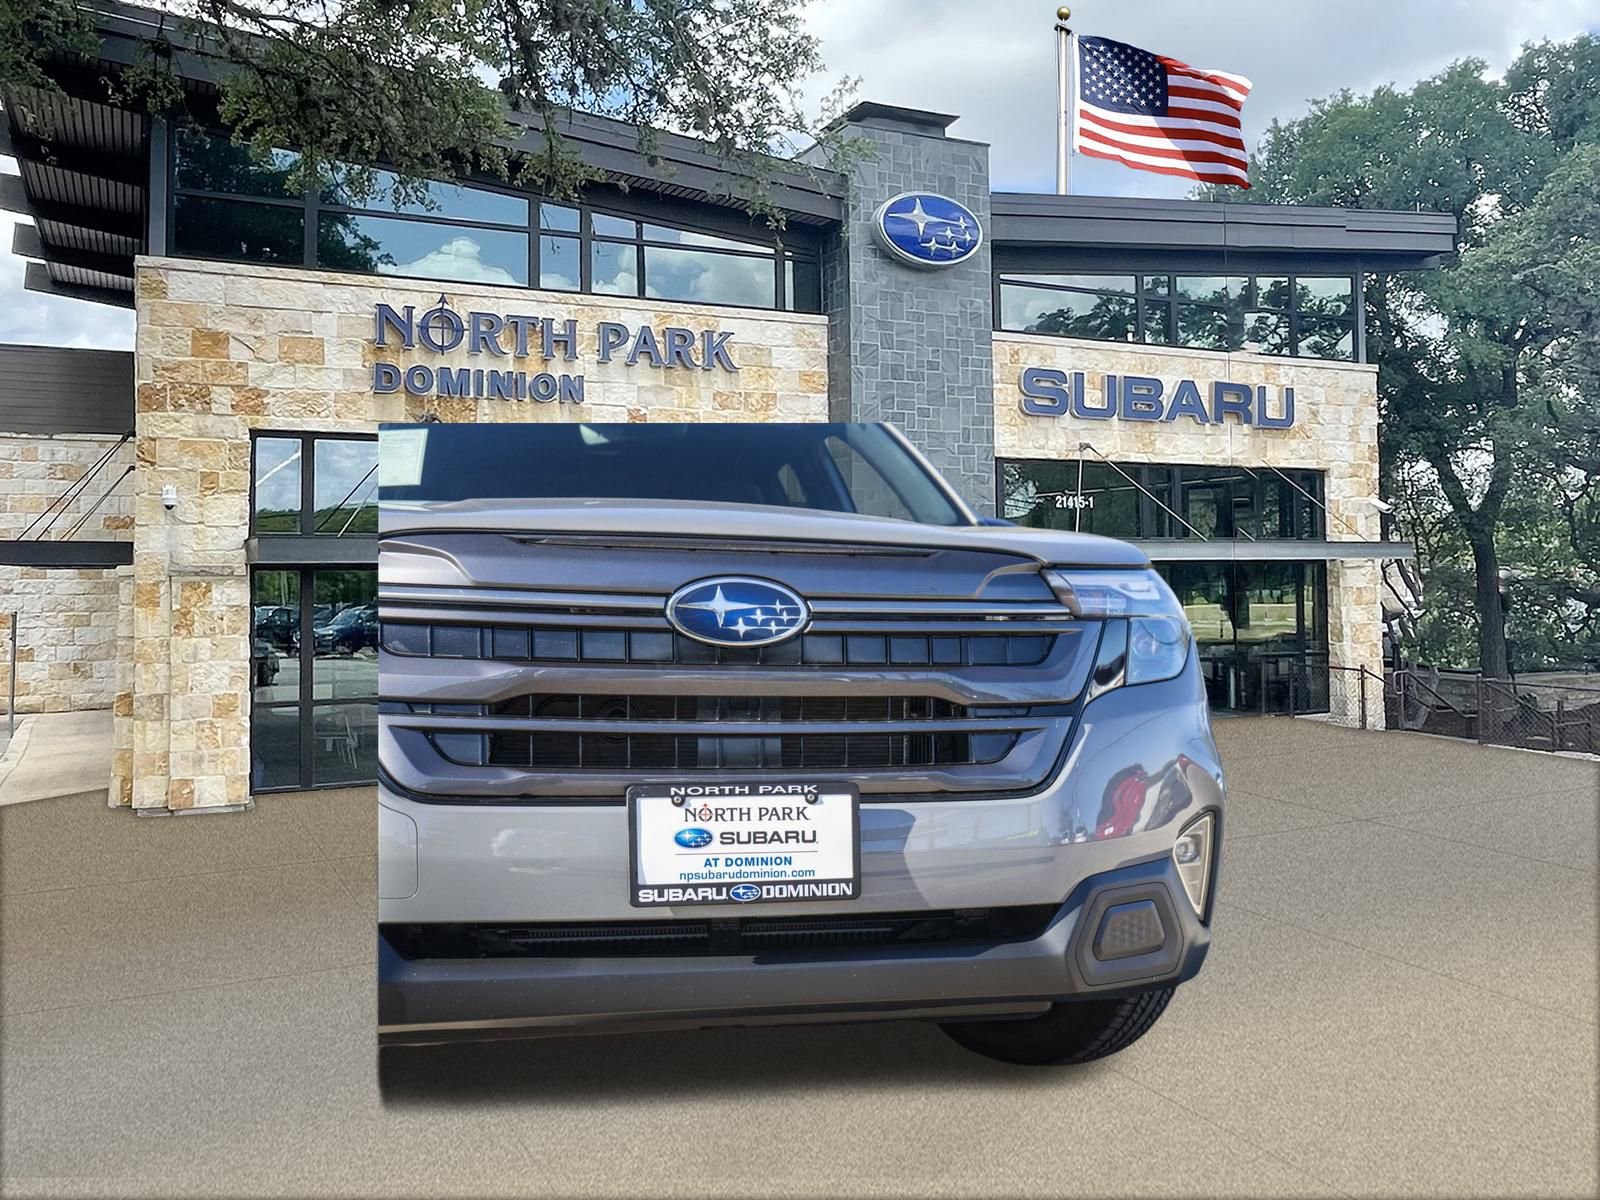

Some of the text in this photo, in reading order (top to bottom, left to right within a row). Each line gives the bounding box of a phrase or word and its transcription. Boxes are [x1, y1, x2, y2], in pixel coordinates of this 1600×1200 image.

[374, 293, 740, 373] NORTH PARK
[373, 362, 585, 405] DOMINION
[1018, 367, 1294, 429] SUBARU
[670, 784, 819, 796] NORTH PARK
[684, 804, 811, 823] NORTH PARK
[719, 829, 819, 845] SUBARU
[704, 856, 792, 868] AT DOMINION
[679, 867, 816, 881] npsubarudominion.com
[638, 883, 853, 903] SUBARU DOMINION
